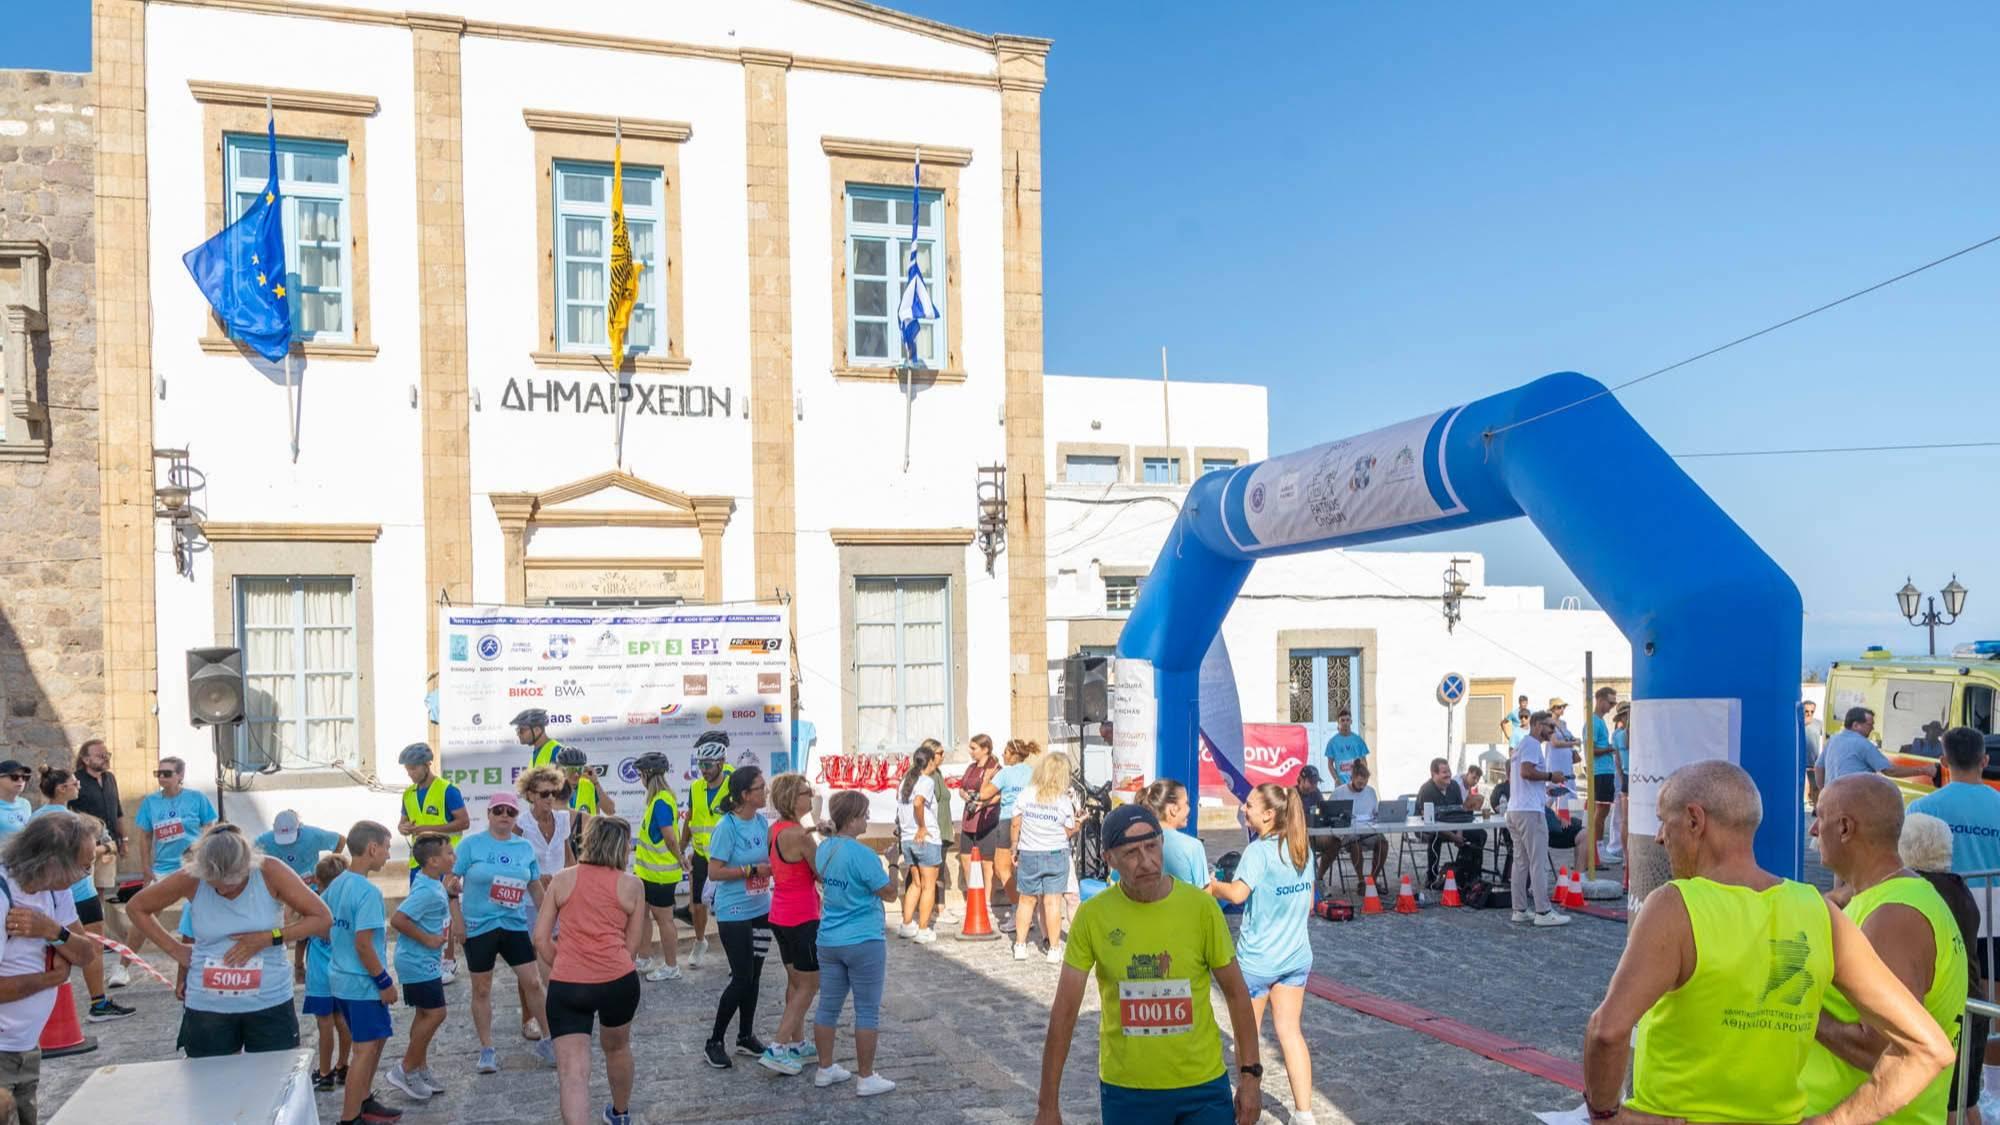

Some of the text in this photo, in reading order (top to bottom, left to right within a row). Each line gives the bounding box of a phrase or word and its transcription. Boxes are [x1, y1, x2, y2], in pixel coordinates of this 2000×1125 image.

[500, 376, 732, 418] ΔΗΜΑΡΧΕΙΟΝ
[628, 640, 660, 655] ΕΡΤ
[691, 638, 719, 649] ΕΡΤ
[509, 687, 544, 697] ΒΙΚΟΣ
[555, 686, 585, 697] BWA
[732, 710, 756, 719] ERGO
[1026, 811, 1058, 822] saucony
[1949, 823, 2000, 840] saucon
[496, 887, 521, 902] 5031
[1275, 882, 1312, 897] saucon
[212, 971, 251, 986] 5004
[1128, 1002, 1187, 1022] 10016
